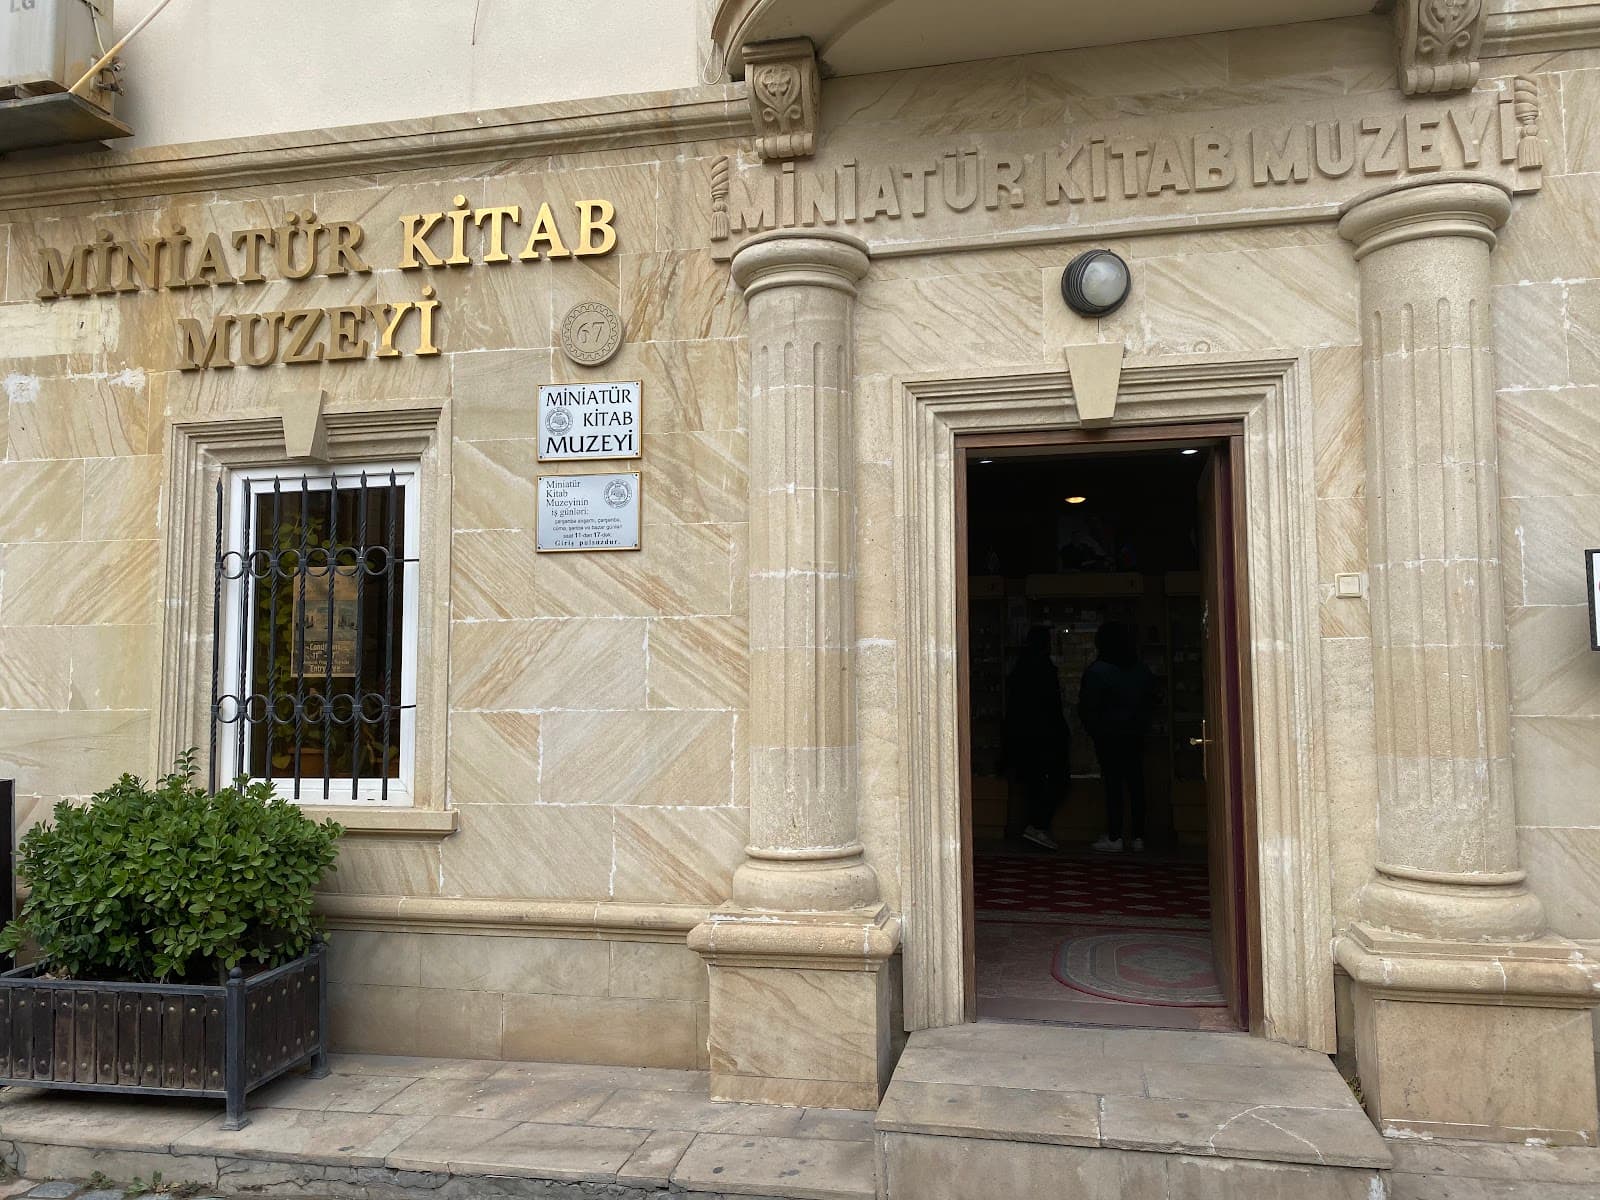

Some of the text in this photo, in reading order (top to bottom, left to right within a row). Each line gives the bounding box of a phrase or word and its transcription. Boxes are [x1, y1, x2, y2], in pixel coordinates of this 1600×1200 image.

[730, 78, 1518, 233] MİNİATÜR KİTAB MUZEYİ
[36, 194, 618, 300] MİNİATÜR KİTAB
[176, 285, 442, 371] MUZEYİ
[576, 321, 605, 344] 67
[546, 386, 632, 407] MİNİATÜR
[583, 408, 633, 427] KİTAB
[546, 429, 633, 454] MUZEYİ
[546, 480, 581, 489] Miniatür
[546, 489, 568, 498] Kitab
[546, 498, 589, 508] Muzeyinin
